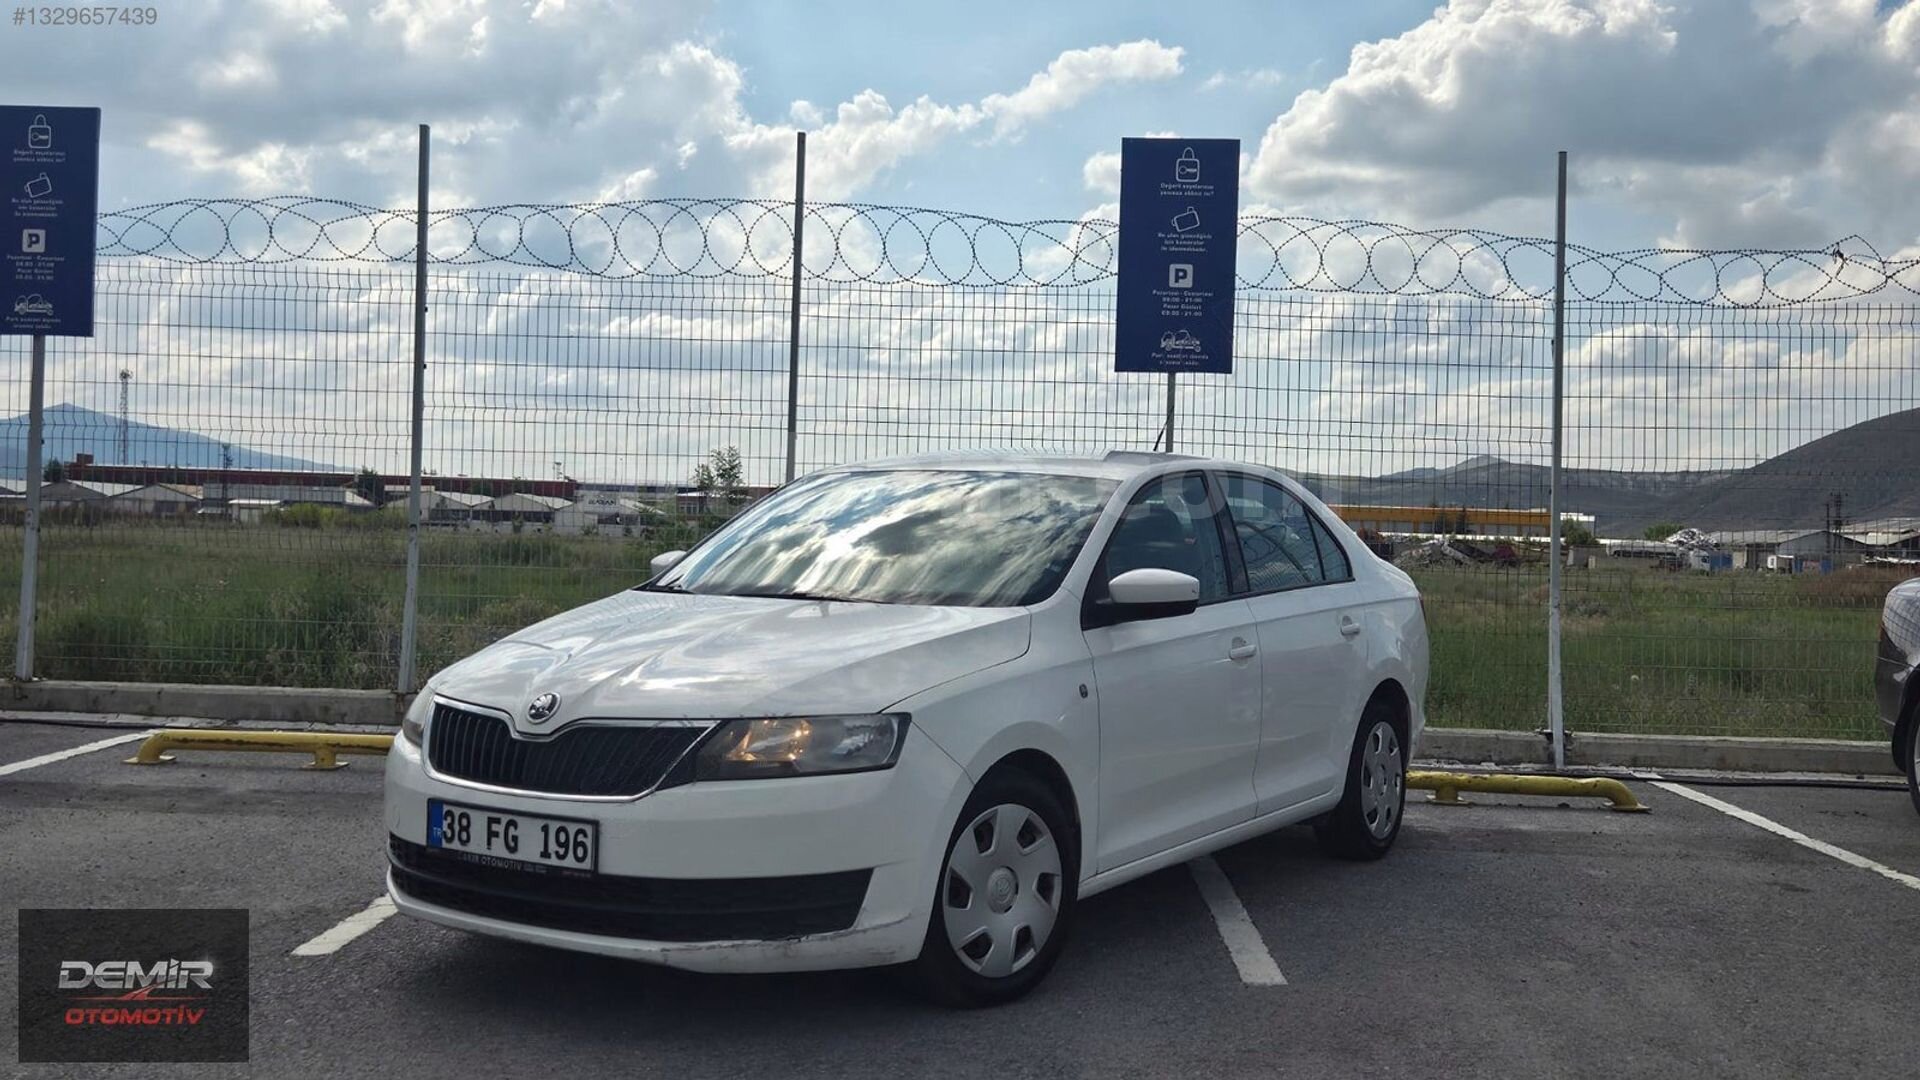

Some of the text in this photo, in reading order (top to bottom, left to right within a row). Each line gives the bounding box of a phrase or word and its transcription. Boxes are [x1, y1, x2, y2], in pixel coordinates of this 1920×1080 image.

[1174, 267, 1188, 284] P
[443, 809, 589, 864] 38 FG 196
